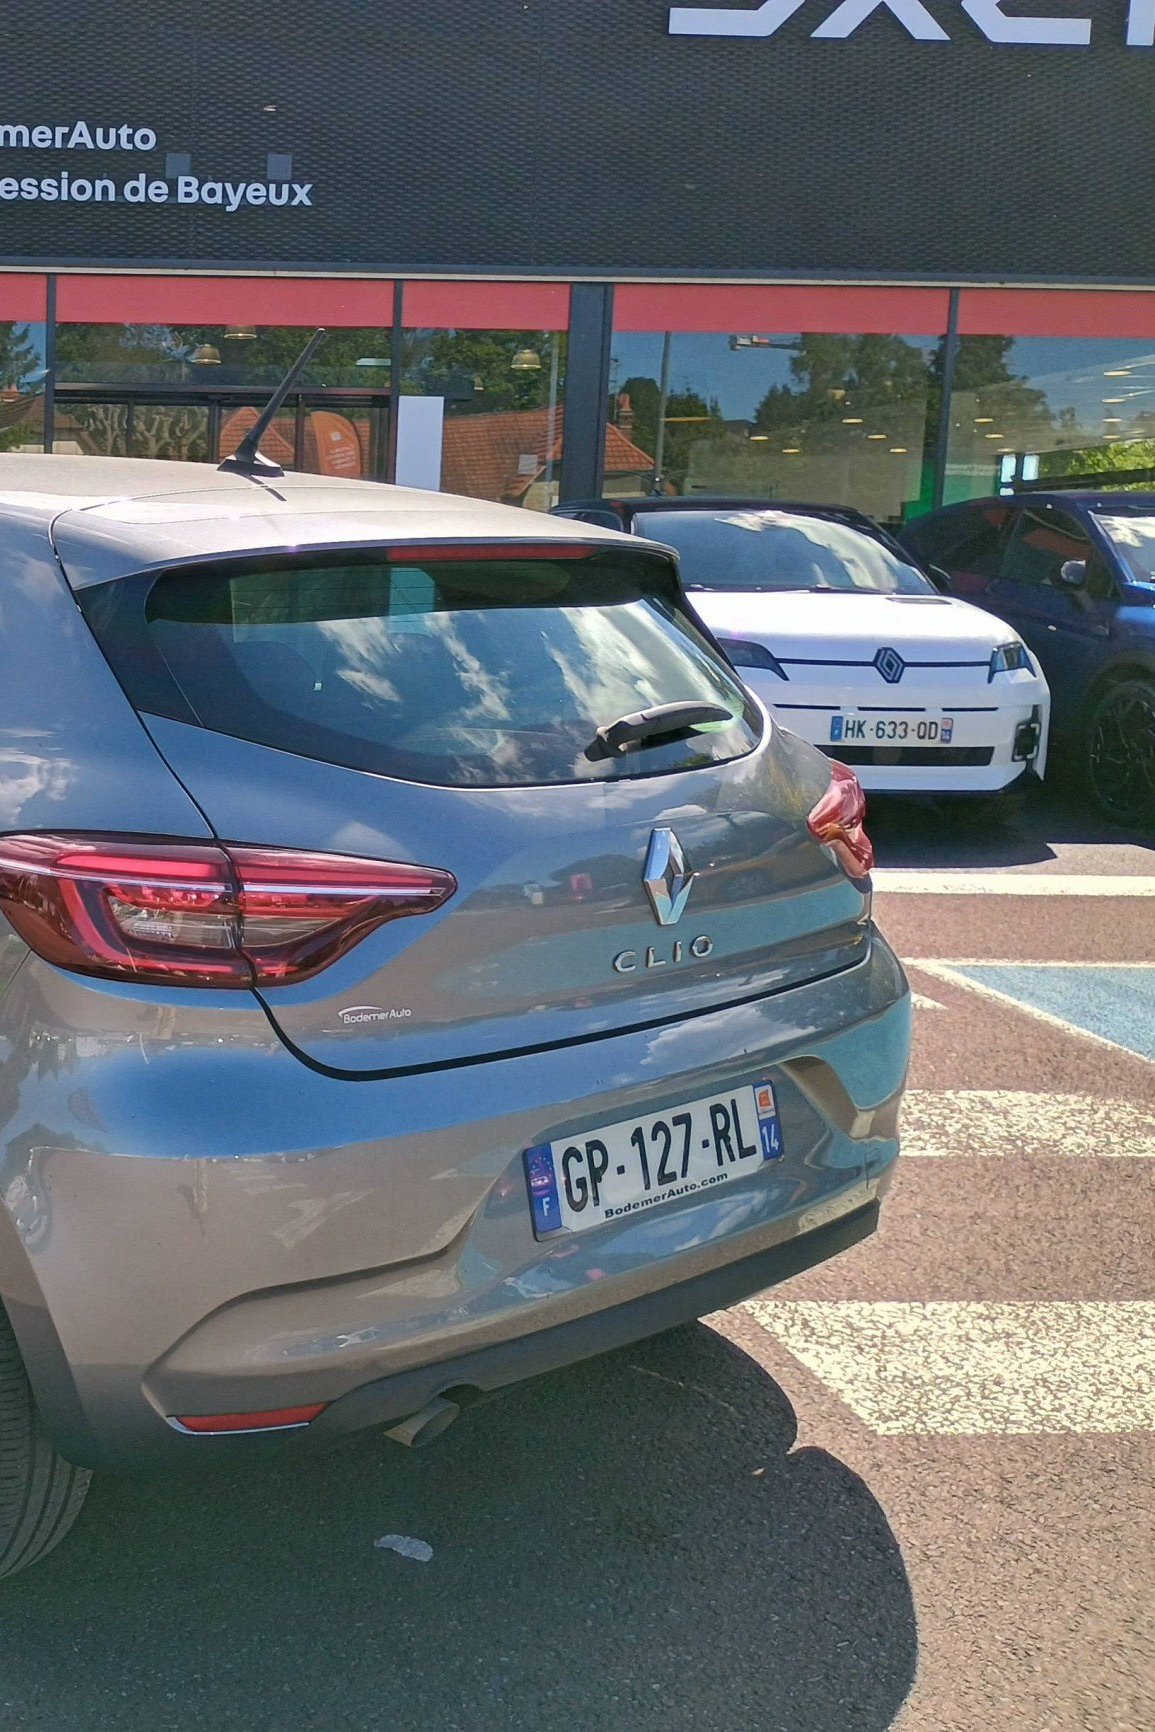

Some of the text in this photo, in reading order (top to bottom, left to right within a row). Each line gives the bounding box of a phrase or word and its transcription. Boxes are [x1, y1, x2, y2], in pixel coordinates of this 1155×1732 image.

[123, 173, 169, 203] de
[177, 175, 313, 212] Bayeux
[844, 719, 939, 740] HK-633-QD
[614, 935, 714, 973] CLIO
[343, 1008, 412, 1024] BodemerAuto
[542, 1098, 780, 1217] F GP-127-RL 14
[604, 1171, 728, 1219] BodemerAuto.com
